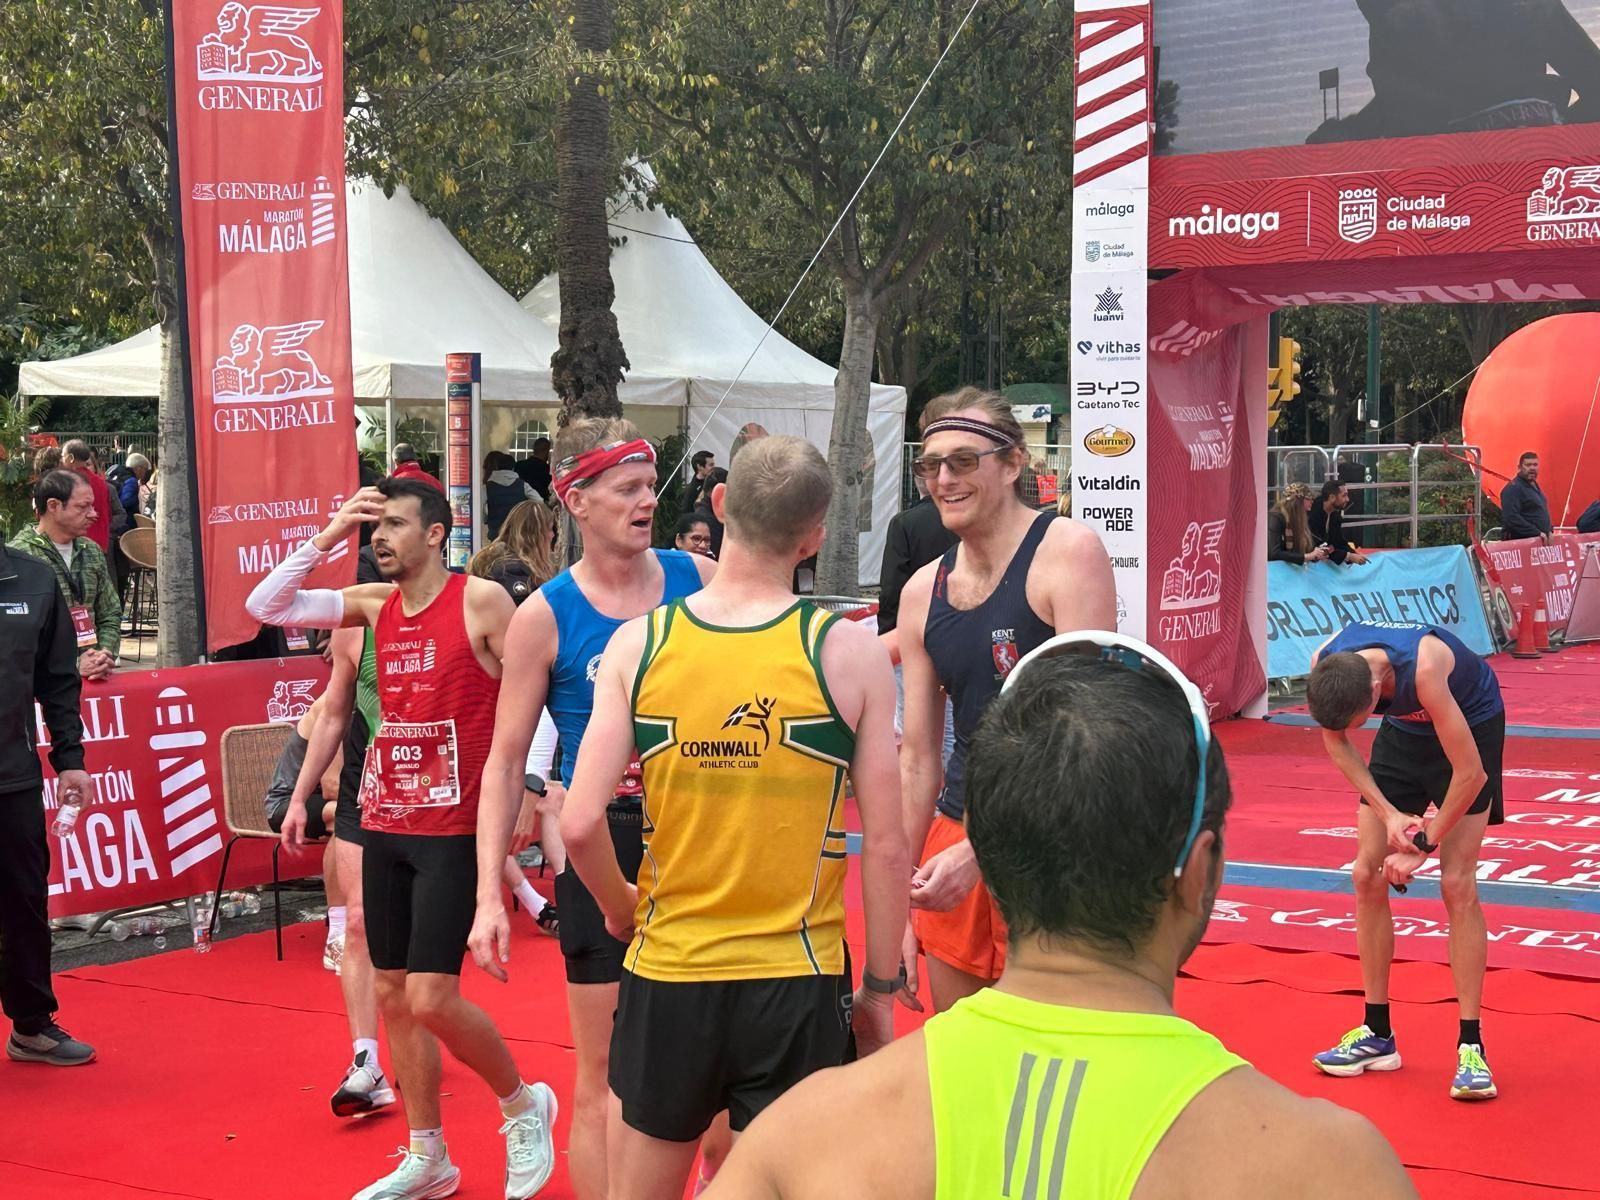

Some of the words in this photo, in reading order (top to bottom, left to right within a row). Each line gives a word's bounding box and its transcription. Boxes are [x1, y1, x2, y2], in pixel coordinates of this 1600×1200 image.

[198, 85, 323, 112] GENERALI
[217, 182, 305, 201] GENERALI
[1386, 193, 1445, 212] Ciudad
[1386, 216, 1407, 231] de
[1411, 213, 1470, 231] Málaga
[219, 219, 307, 253] MÁLAGA
[1527, 221, 1600, 241] GENERA
[1094, 312, 1124, 322] luanvi
[1096, 341, 1141, 354] vithas
[1077, 381, 1140, 396] BYD
[1077, 400, 1120, 409] Caetano
[1121, 399, 1140, 409] Tec
[214, 400, 336, 432] GENERALI
[1089, 437, 1129, 446] Gourmet
[1078, 475, 1141, 490] Vitaldin
[234, 498, 319, 521] GENERALI
[1082, 507, 1133, 520] POWER
[1105, 520, 1134, 532] ADE
[1331, 583, 1461, 625] ATHLETICS
[991, 628, 1015, 639] KENT
[389, 726, 439, 738] GENERALI
[391, 745, 423, 761] 603
[680, 741, 761, 757] CORNWALL
[699, 760, 735, 769] ATHLETIC
[738, 760, 758, 769] CLUB
[42, 765, 135, 809] MTÓN
[48, 809, 159, 895] AGA
